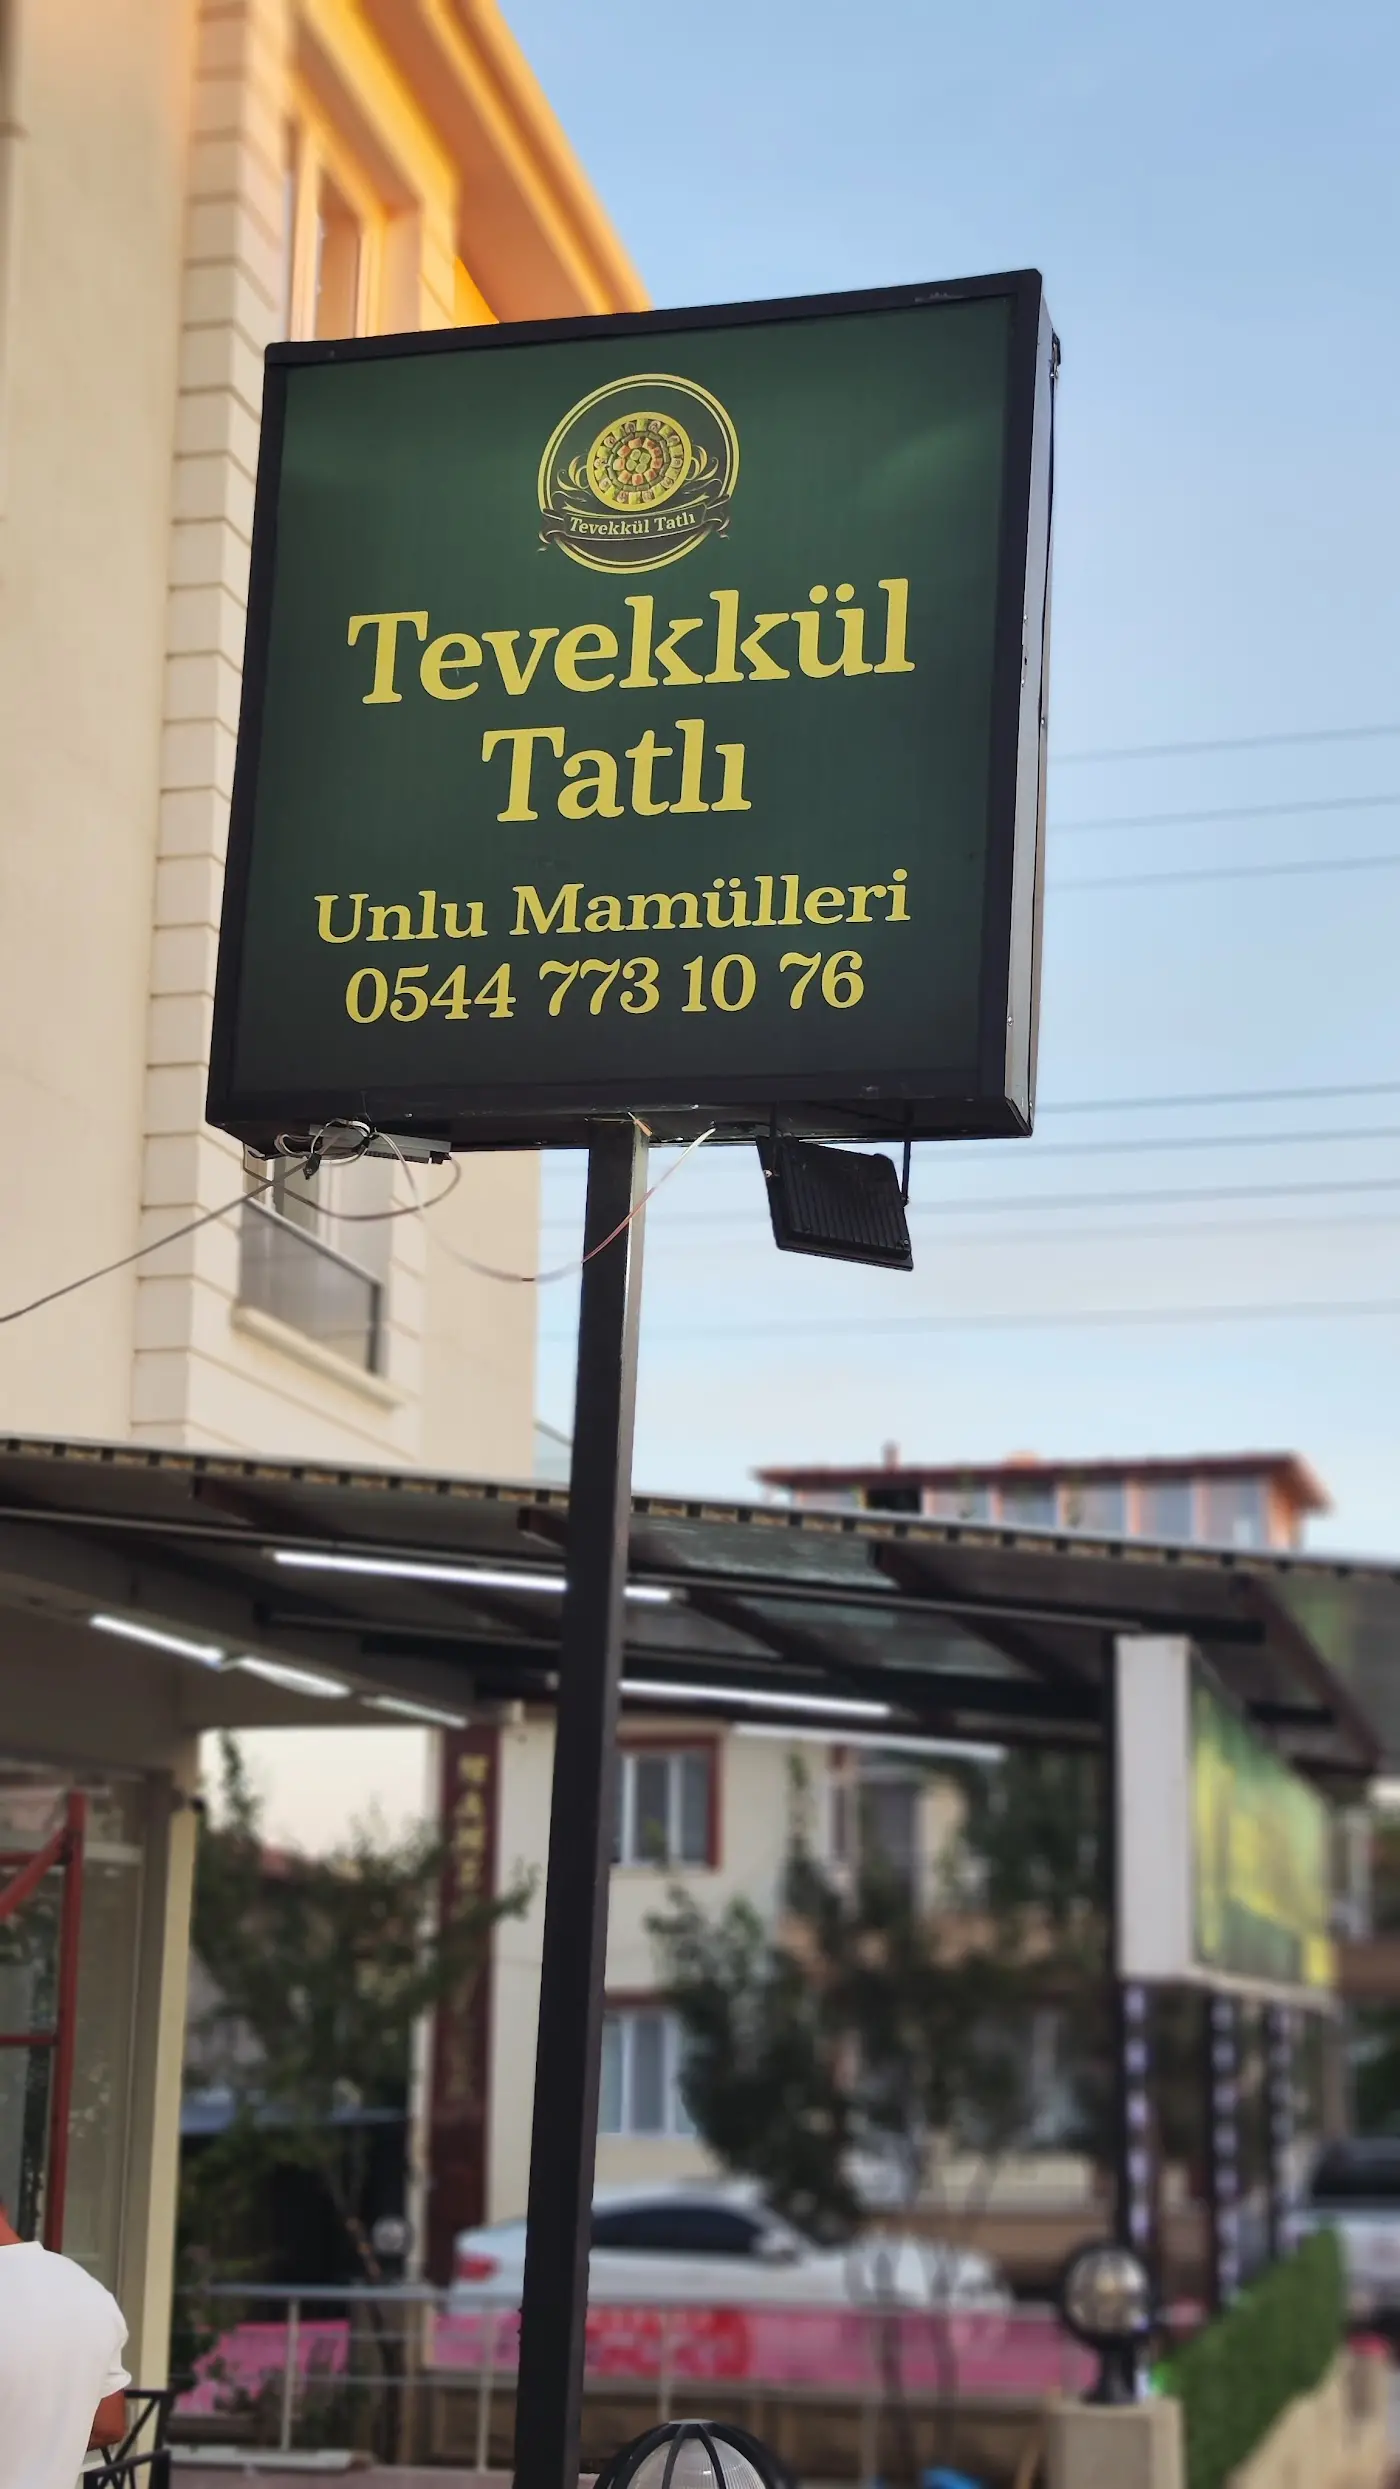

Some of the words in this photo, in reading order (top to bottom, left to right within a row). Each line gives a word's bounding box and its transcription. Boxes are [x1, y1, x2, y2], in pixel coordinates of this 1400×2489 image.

[569, 516, 650, 535] Tevekkül
[653, 511, 696, 531] Tatlı
[346, 577, 916, 705] Tevekkül
[481, 718, 752, 823] Tatlı
[315, 890, 486, 944] Unlu
[510, 868, 911, 937] Mamülleri
[345, 963, 515, 1024] 0544
[538, 956, 661, 1016] 773
[681, 953, 757, 1012] 10
[779, 950, 865, 1010] 76
